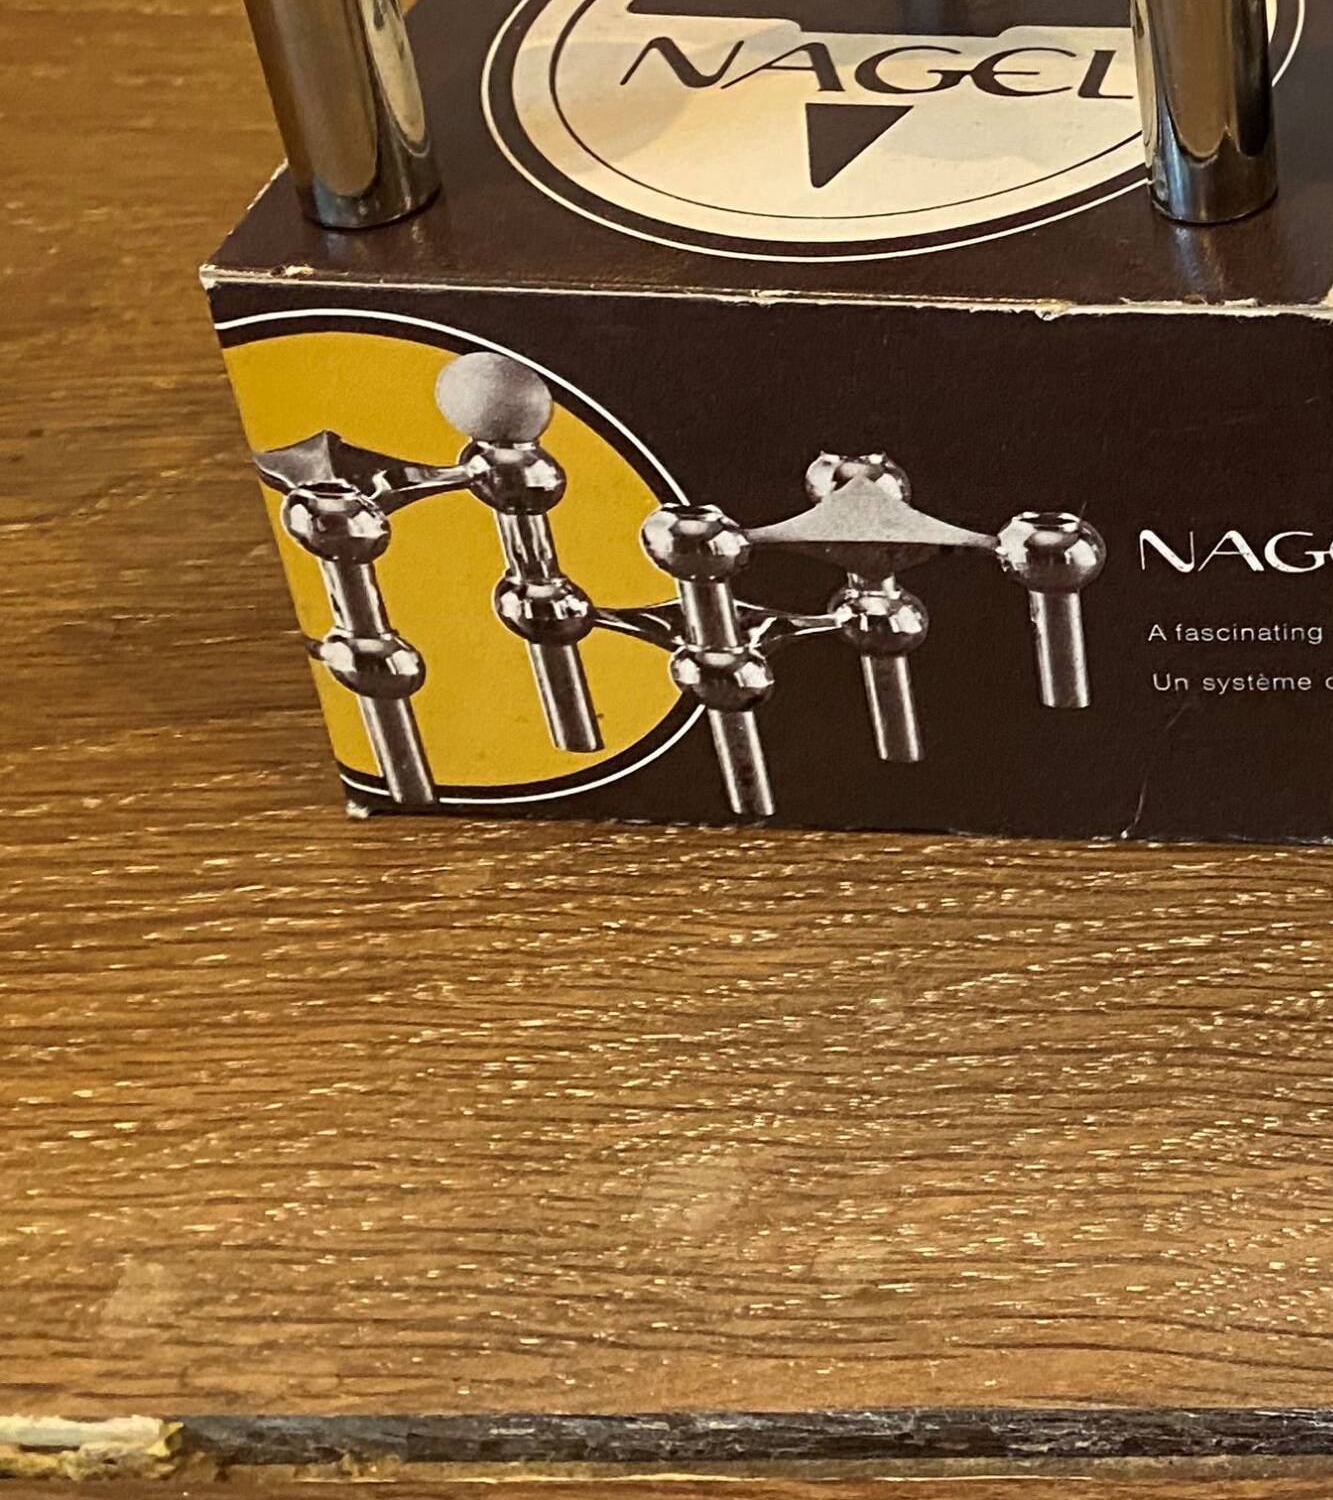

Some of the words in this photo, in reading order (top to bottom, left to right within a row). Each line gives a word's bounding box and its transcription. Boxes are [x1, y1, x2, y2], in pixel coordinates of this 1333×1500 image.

[620, 36, 1134, 100] NAGEL
[1148, 623, 1168, 642] A
[1175, 623, 1323, 645] fascinating
[1152, 672, 1189, 692] Un
[1202, 673, 1313, 696] système
